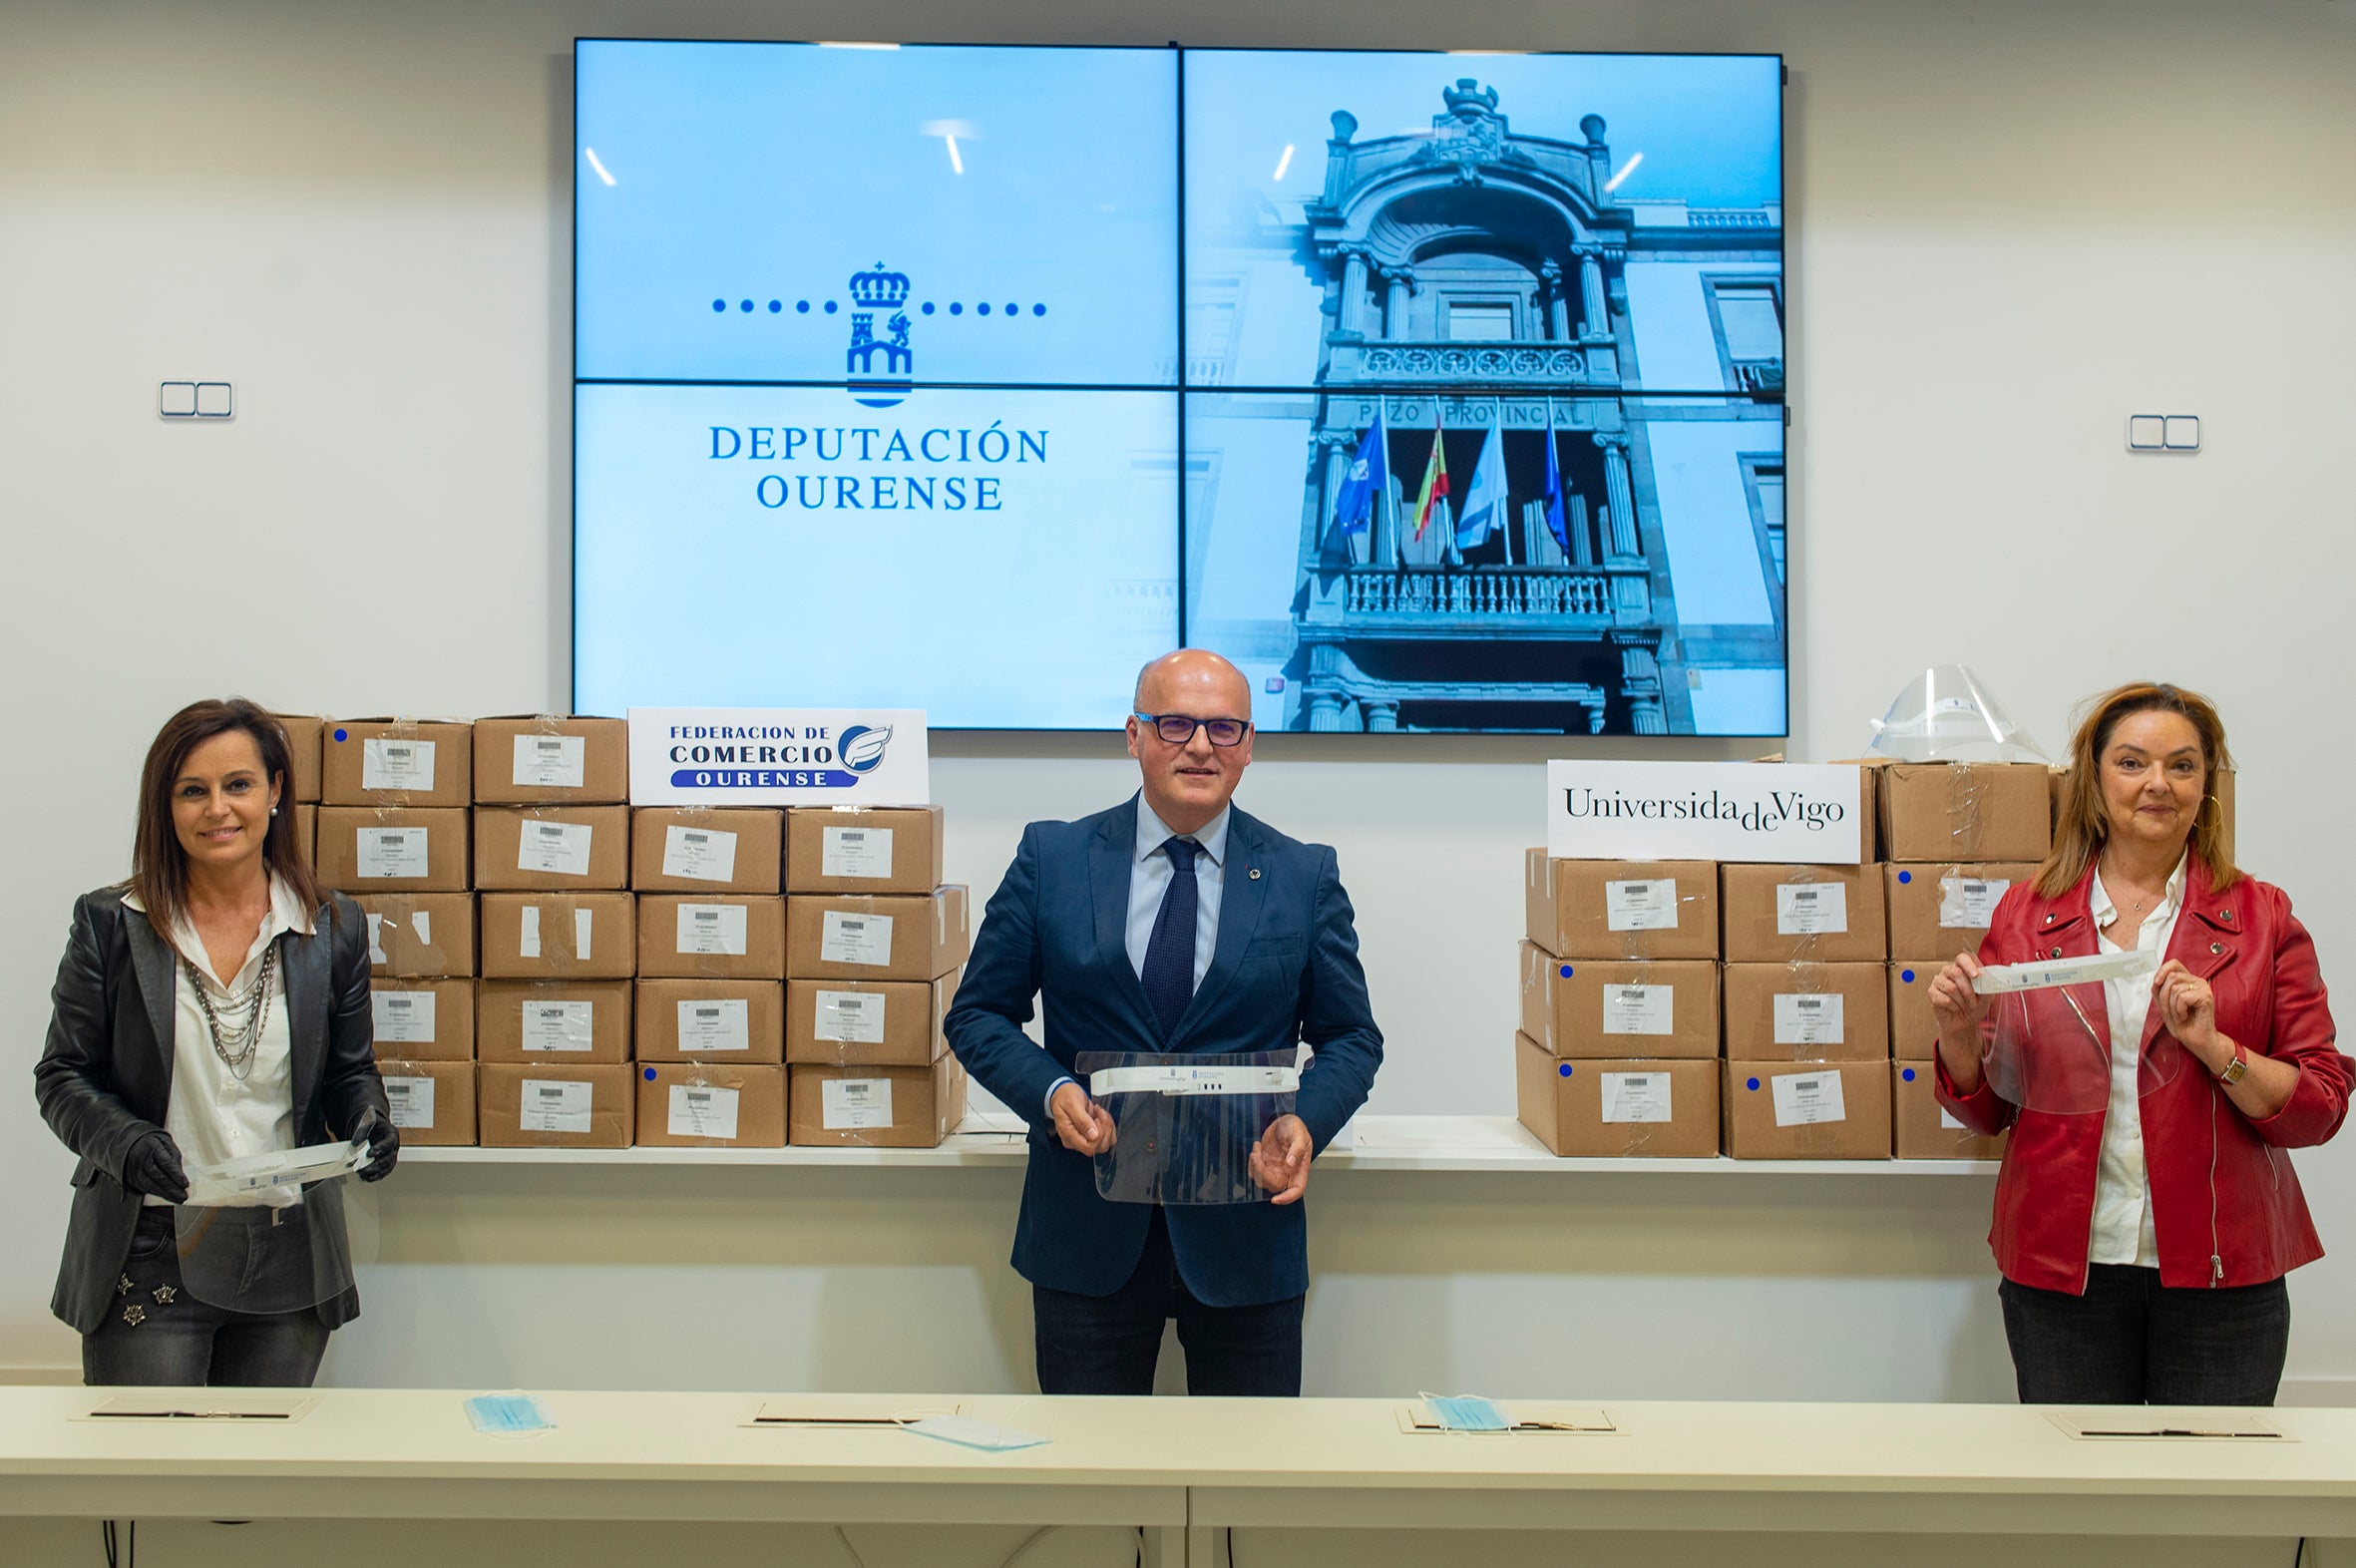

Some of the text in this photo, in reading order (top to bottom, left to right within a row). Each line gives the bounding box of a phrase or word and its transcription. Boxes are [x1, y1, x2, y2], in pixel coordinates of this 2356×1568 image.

[1360, 404, 1419, 422] PZO
[709, 419, 1049, 464] DEPUTACIÓN
[756, 474, 1002, 511] OURENSE
[669, 726, 830, 740] FEDERACION DE
[669, 745, 833, 764] COMERCIO
[695, 771, 827, 786] OURENSE
